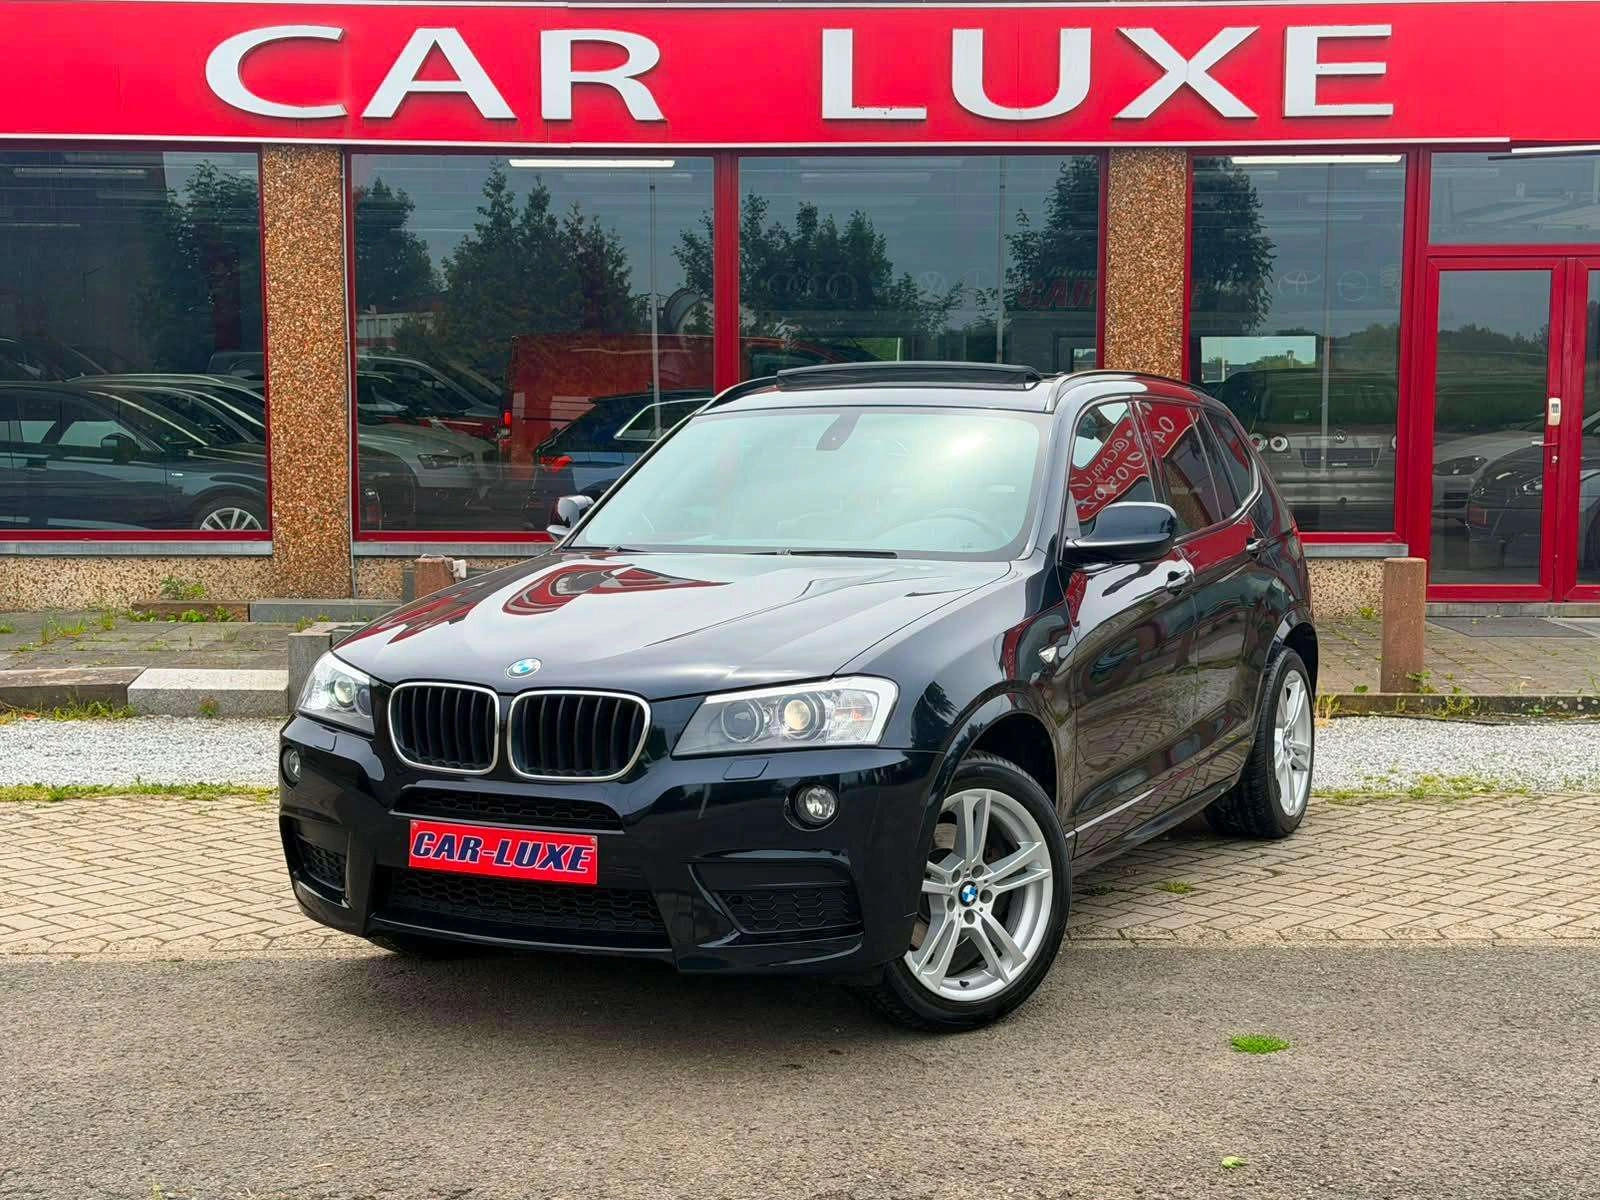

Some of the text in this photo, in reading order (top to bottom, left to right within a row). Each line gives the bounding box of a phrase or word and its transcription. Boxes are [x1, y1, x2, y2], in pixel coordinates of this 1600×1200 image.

[206, 24, 1393, 120] CAR LUXE
[411, 831, 593, 873] CAR-LUXE
